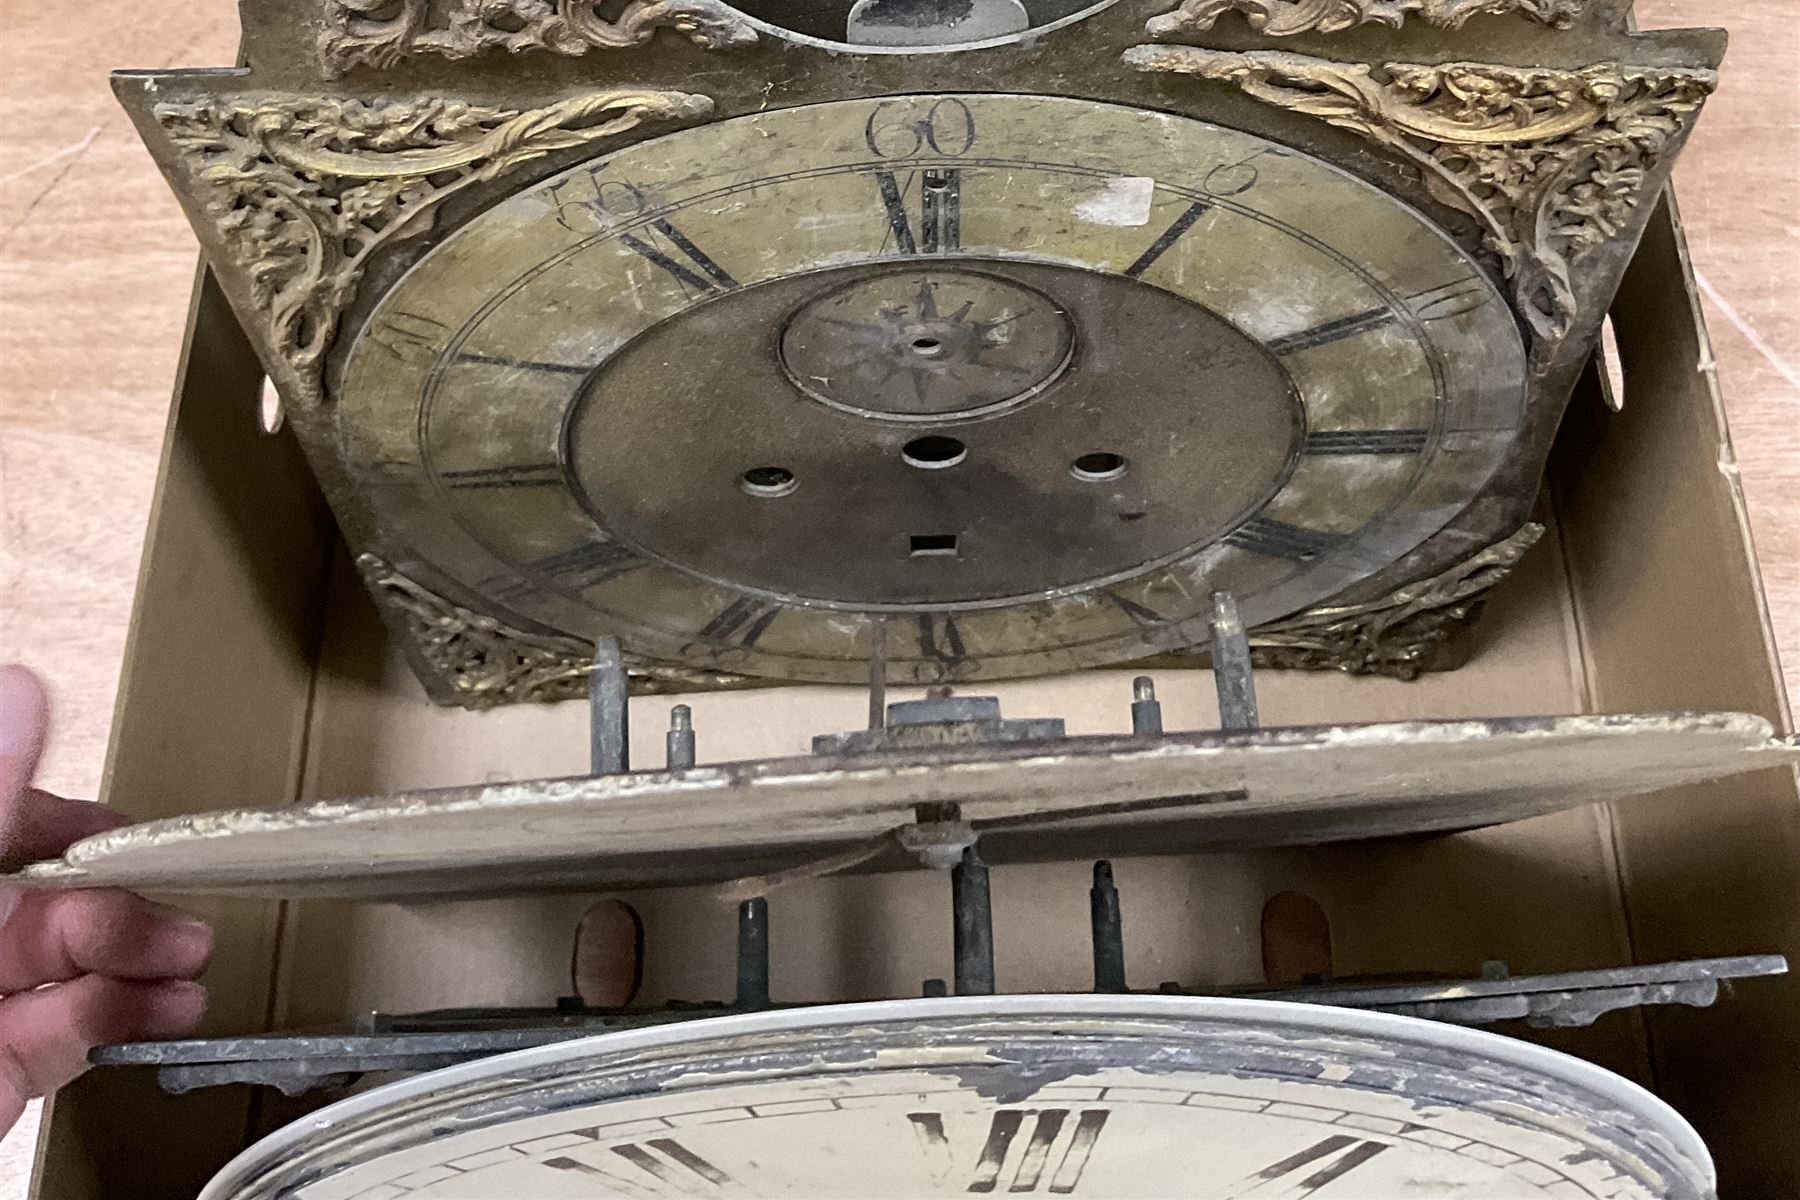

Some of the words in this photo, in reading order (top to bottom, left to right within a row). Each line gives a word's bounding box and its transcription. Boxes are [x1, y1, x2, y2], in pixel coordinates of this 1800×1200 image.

[865, 97, 976, 158] 60
[550, 160, 646, 234] 55
[1204, 148, 1291, 197] 5
[860, 168, 978, 254] XII
